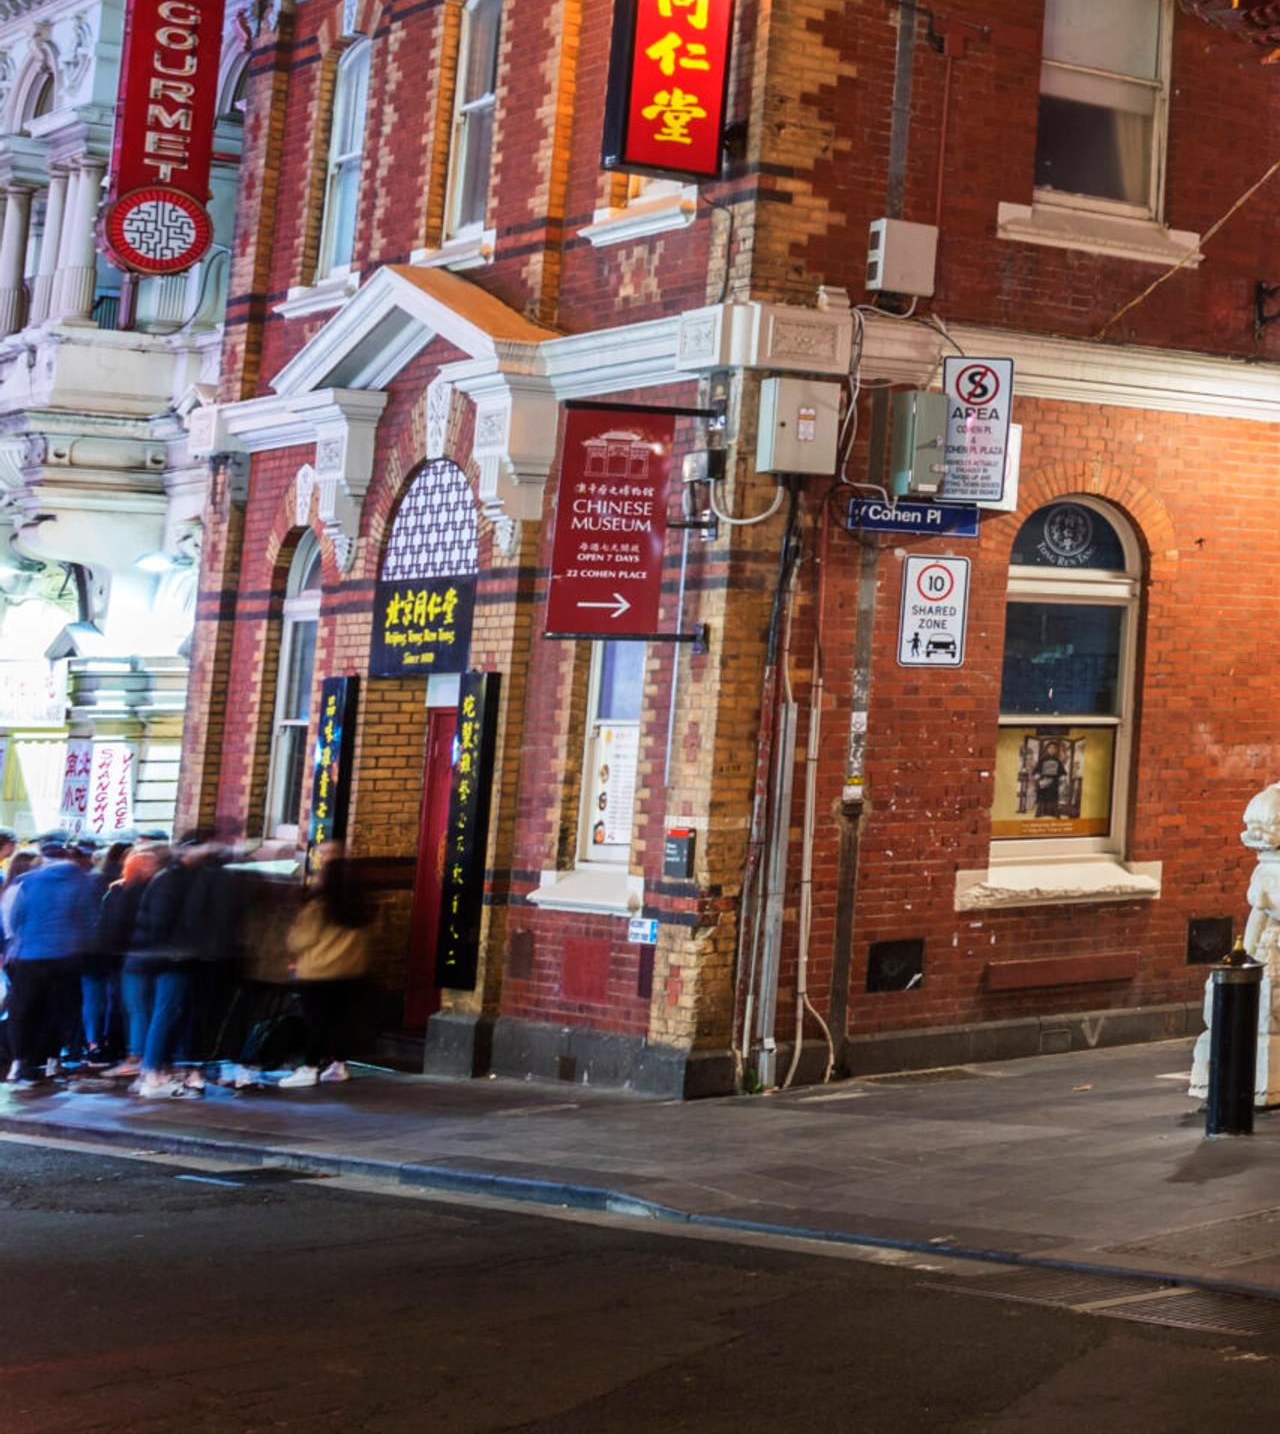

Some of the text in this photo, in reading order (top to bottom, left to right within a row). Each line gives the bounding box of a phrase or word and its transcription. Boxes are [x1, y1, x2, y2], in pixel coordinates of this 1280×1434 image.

[143, 0, 201, 185] GOURMET
[952, 407, 1000, 421] AREA
[573, 499, 652, 516] CHINESE
[868, 505, 941, 524] Cohen Pl
[571, 517, 651, 532] MUSEUM
[577, 553, 640, 563] OPEN 7 DAYS
[566, 569, 647, 579] 22 COHEN PLACE
[928, 576, 944, 592] 10
[912, 605, 956, 616] SHARED
[918, 619, 947, 630] ZONE
[91, 749, 114, 834] SHANGHAI
[113, 753, 135, 830] VILLAGE
